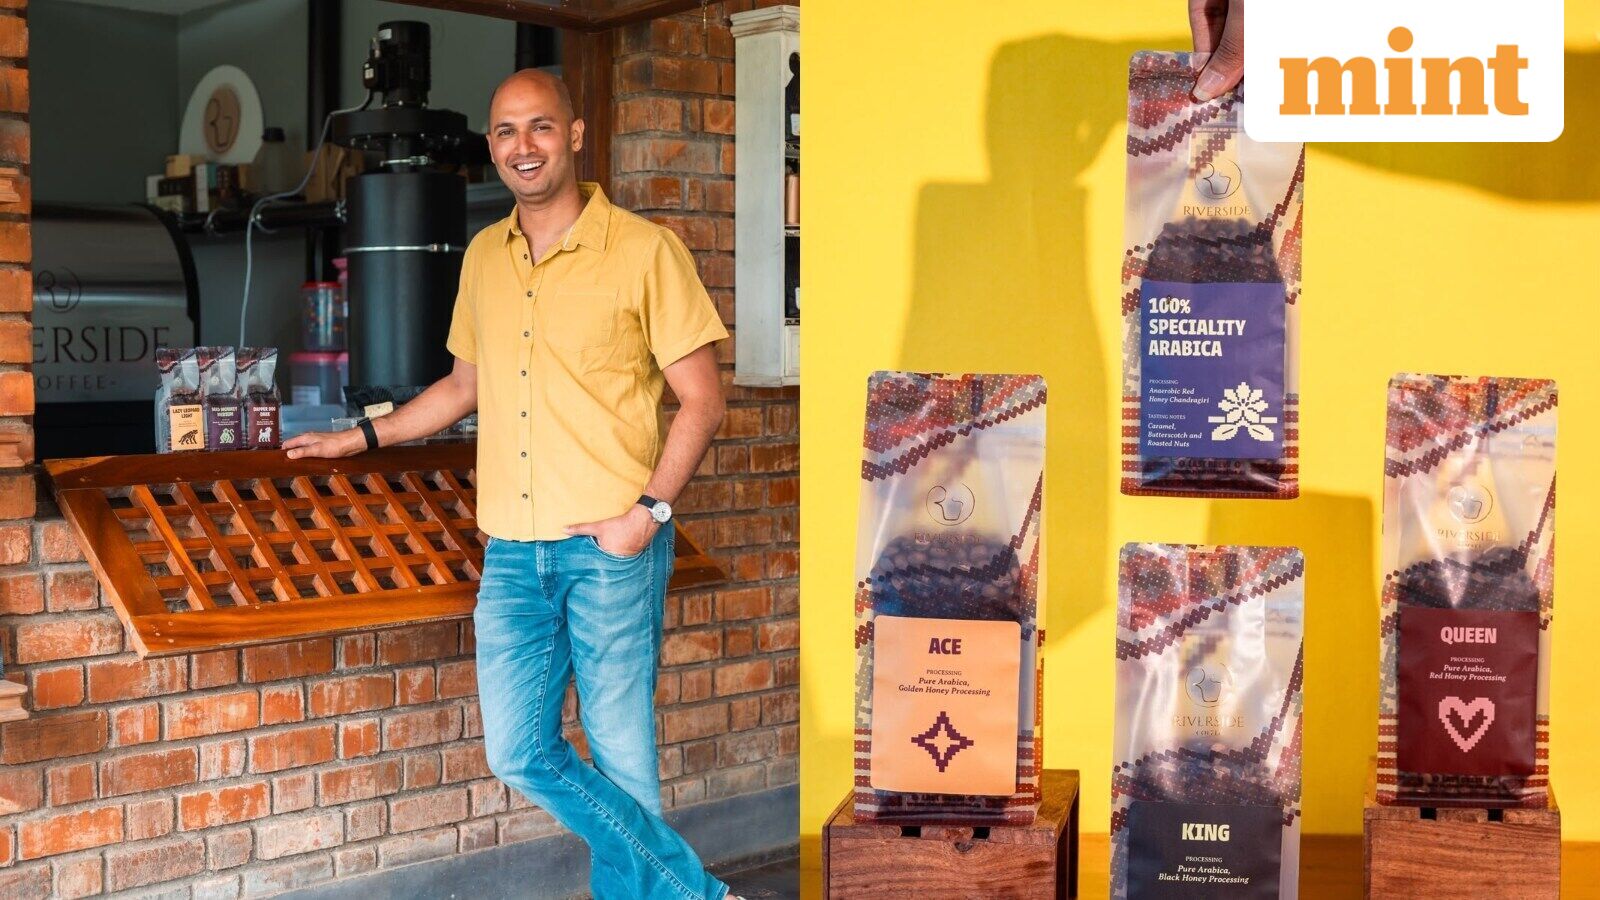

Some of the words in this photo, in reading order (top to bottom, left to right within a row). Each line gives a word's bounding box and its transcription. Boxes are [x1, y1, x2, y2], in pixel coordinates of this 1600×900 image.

[1183, 205, 1251, 216] RIVERSIDE
[1149, 298, 1191, 314] 100%
[1149, 319, 1246, 336] SPECIALITY
[1148, 340, 1223, 357] ARABICA
[1149, 396, 1168, 404] Honey
[1169, 397, 1210, 405] Chandragiri
[1440, 626, 1497, 645] QUEEN
[928, 637, 962, 655] ACE
[1443, 664, 1461, 672] Pure
[1462, 665, 1493, 674] Arabica,
[918, 677, 939, 685] Pure
[940, 678, 970, 687] Arabica,
[1444, 673, 1468, 681] Honey
[1468, 673, 1507, 682] Processing
[898, 684, 924, 693] Golden
[925, 686, 949, 695] Honey
[951, 687, 991, 697] Processing
[1181, 822, 1230, 842] KING
[1177, 865, 1196, 873] Pure
[1198, 866, 1231, 875] Arabica,
[1158, 873, 1180, 881] Black
[1181, 874, 1207, 884] Honey
[1208, 875, 1250, 885] Processing
